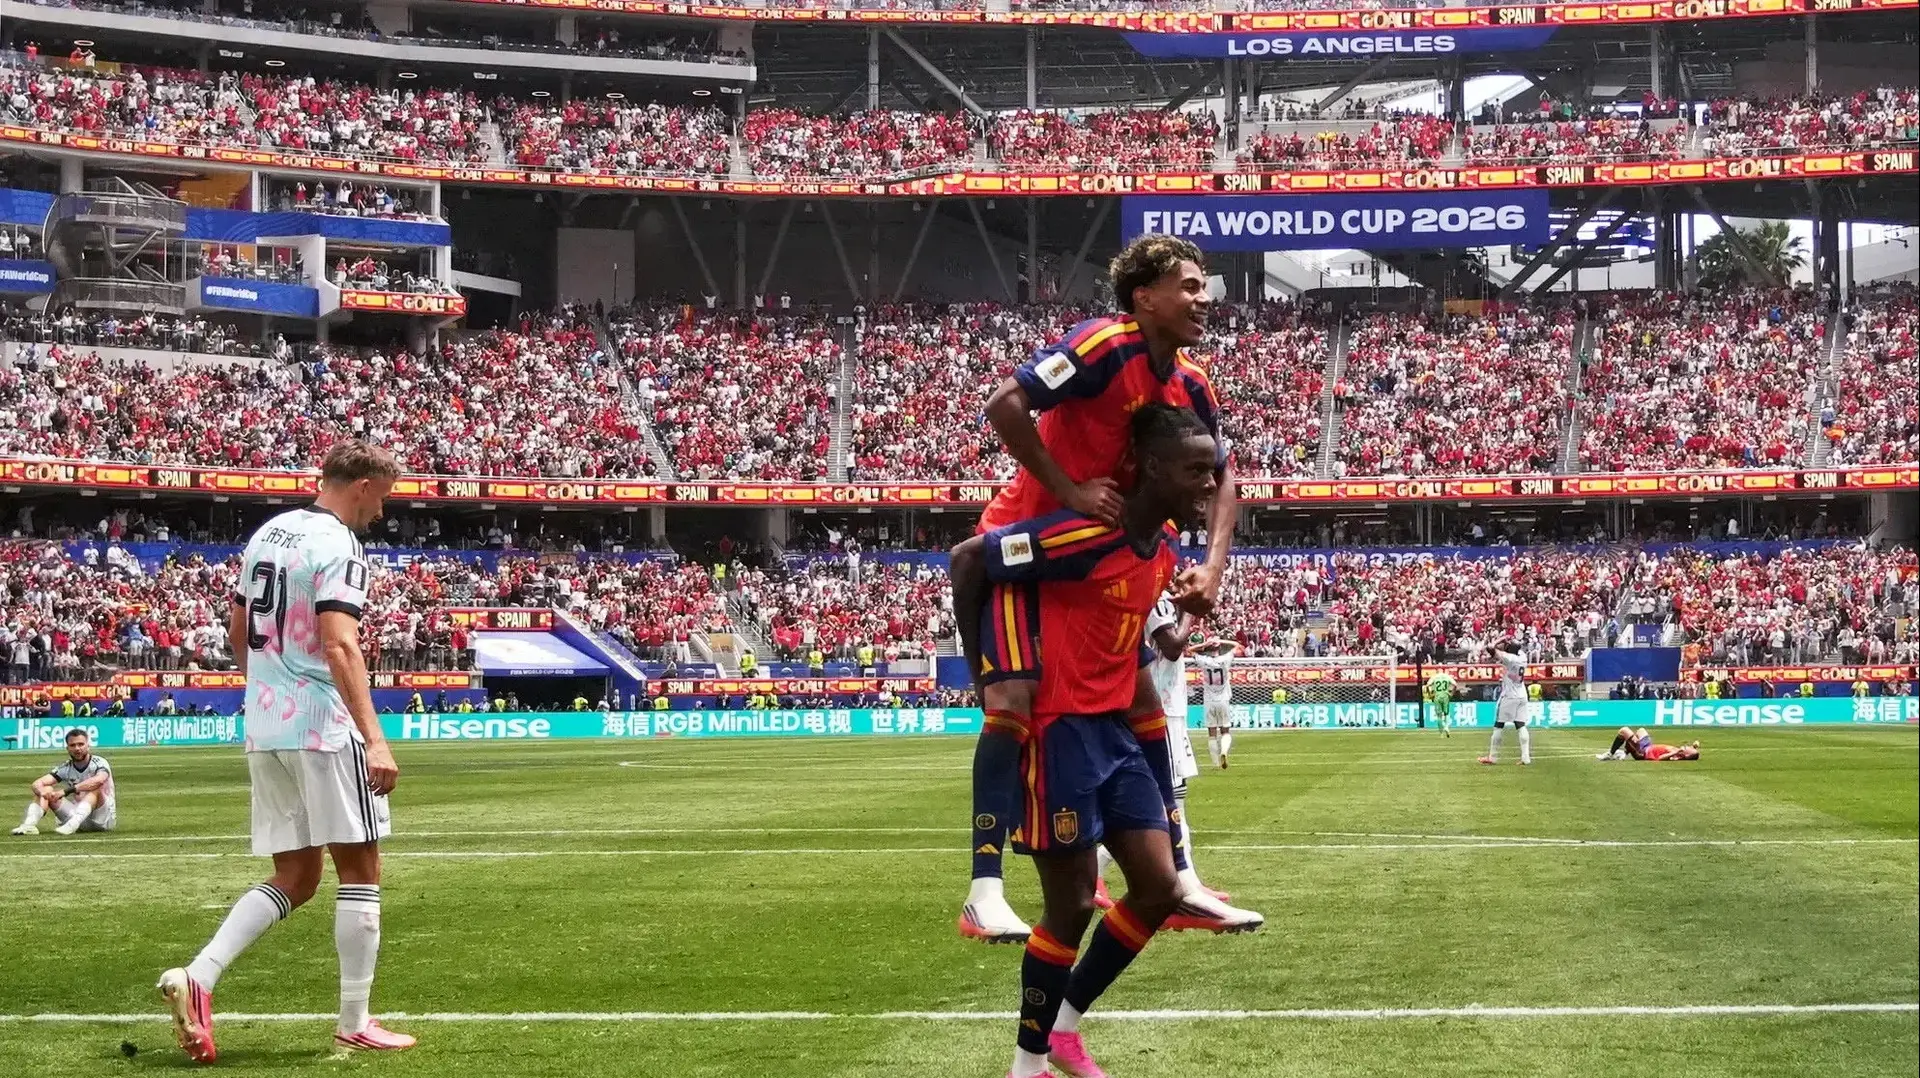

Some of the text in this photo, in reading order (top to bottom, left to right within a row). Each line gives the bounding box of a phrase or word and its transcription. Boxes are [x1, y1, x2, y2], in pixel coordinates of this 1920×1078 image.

[827, 10, 846, 20] SPAIN
[1499, 8, 1536, 25] SPAIN
[1674, 0, 1725, 17] GOAL!
[1361, 11, 1410, 29] GOAL!
[1228, 34, 1456, 56] LOS ANGELES
[40, 131, 62, 145] SPAIN
[183, 146, 205, 159] SPAIN
[358, 162, 379, 174] SPAIN
[1728, 158, 1781, 178] GOAL!
[1874, 153, 1913, 171] SPAIN
[530, 172, 551, 184] SPAIN
[1081, 173, 1133, 193] GOAL!
[1223, 174, 1261, 192] SPAIN
[1404, 169, 1455, 188] GOAL!
[1547, 167, 1585, 184] SPAIN
[699, 181, 719, 191] SPAIN
[865, 184, 885, 195] SPAIN
[1143, 205, 1526, 236] FIFA WORLD CUP 2026
[403, 295, 445, 312] GOAL!
[25, 463, 74, 482] GOAL!
[157, 469, 191, 488] SPAIN
[1803, 473, 1837, 488] SPAIN
[446, 481, 480, 498] SPAIN
[1397, 481, 1441, 497] GOAL!
[1520, 479, 1554, 495] SPAIN
[1677, 474, 1724, 491] GOAL!
[547, 483, 594, 500] GOAL!
[675, 486, 709, 501] SPAIN
[833, 487, 880, 502] GOAL!
[959, 486, 992, 501] SPAIN
[1240, 484, 1274, 500] SPAIN
[1261, 554, 1328, 568] WORD
[247, 560, 288, 653] 21
[497, 612, 532, 628] SPAIN
[162, 673, 185, 687] SPAIN
[1206, 668, 1224, 686] 17
[1552, 666, 1577, 677] SPAIN
[667, 681, 694, 694] SPAIN
[1435, 680, 1448, 692] 23
[871, 708, 972, 734] 世界第一
[1526, 701, 1598, 726] 界第一
[1655, 700, 1805, 725] Hisense
[17, 718, 99, 749] Hisee
[402, 714, 551, 739] Hisense
